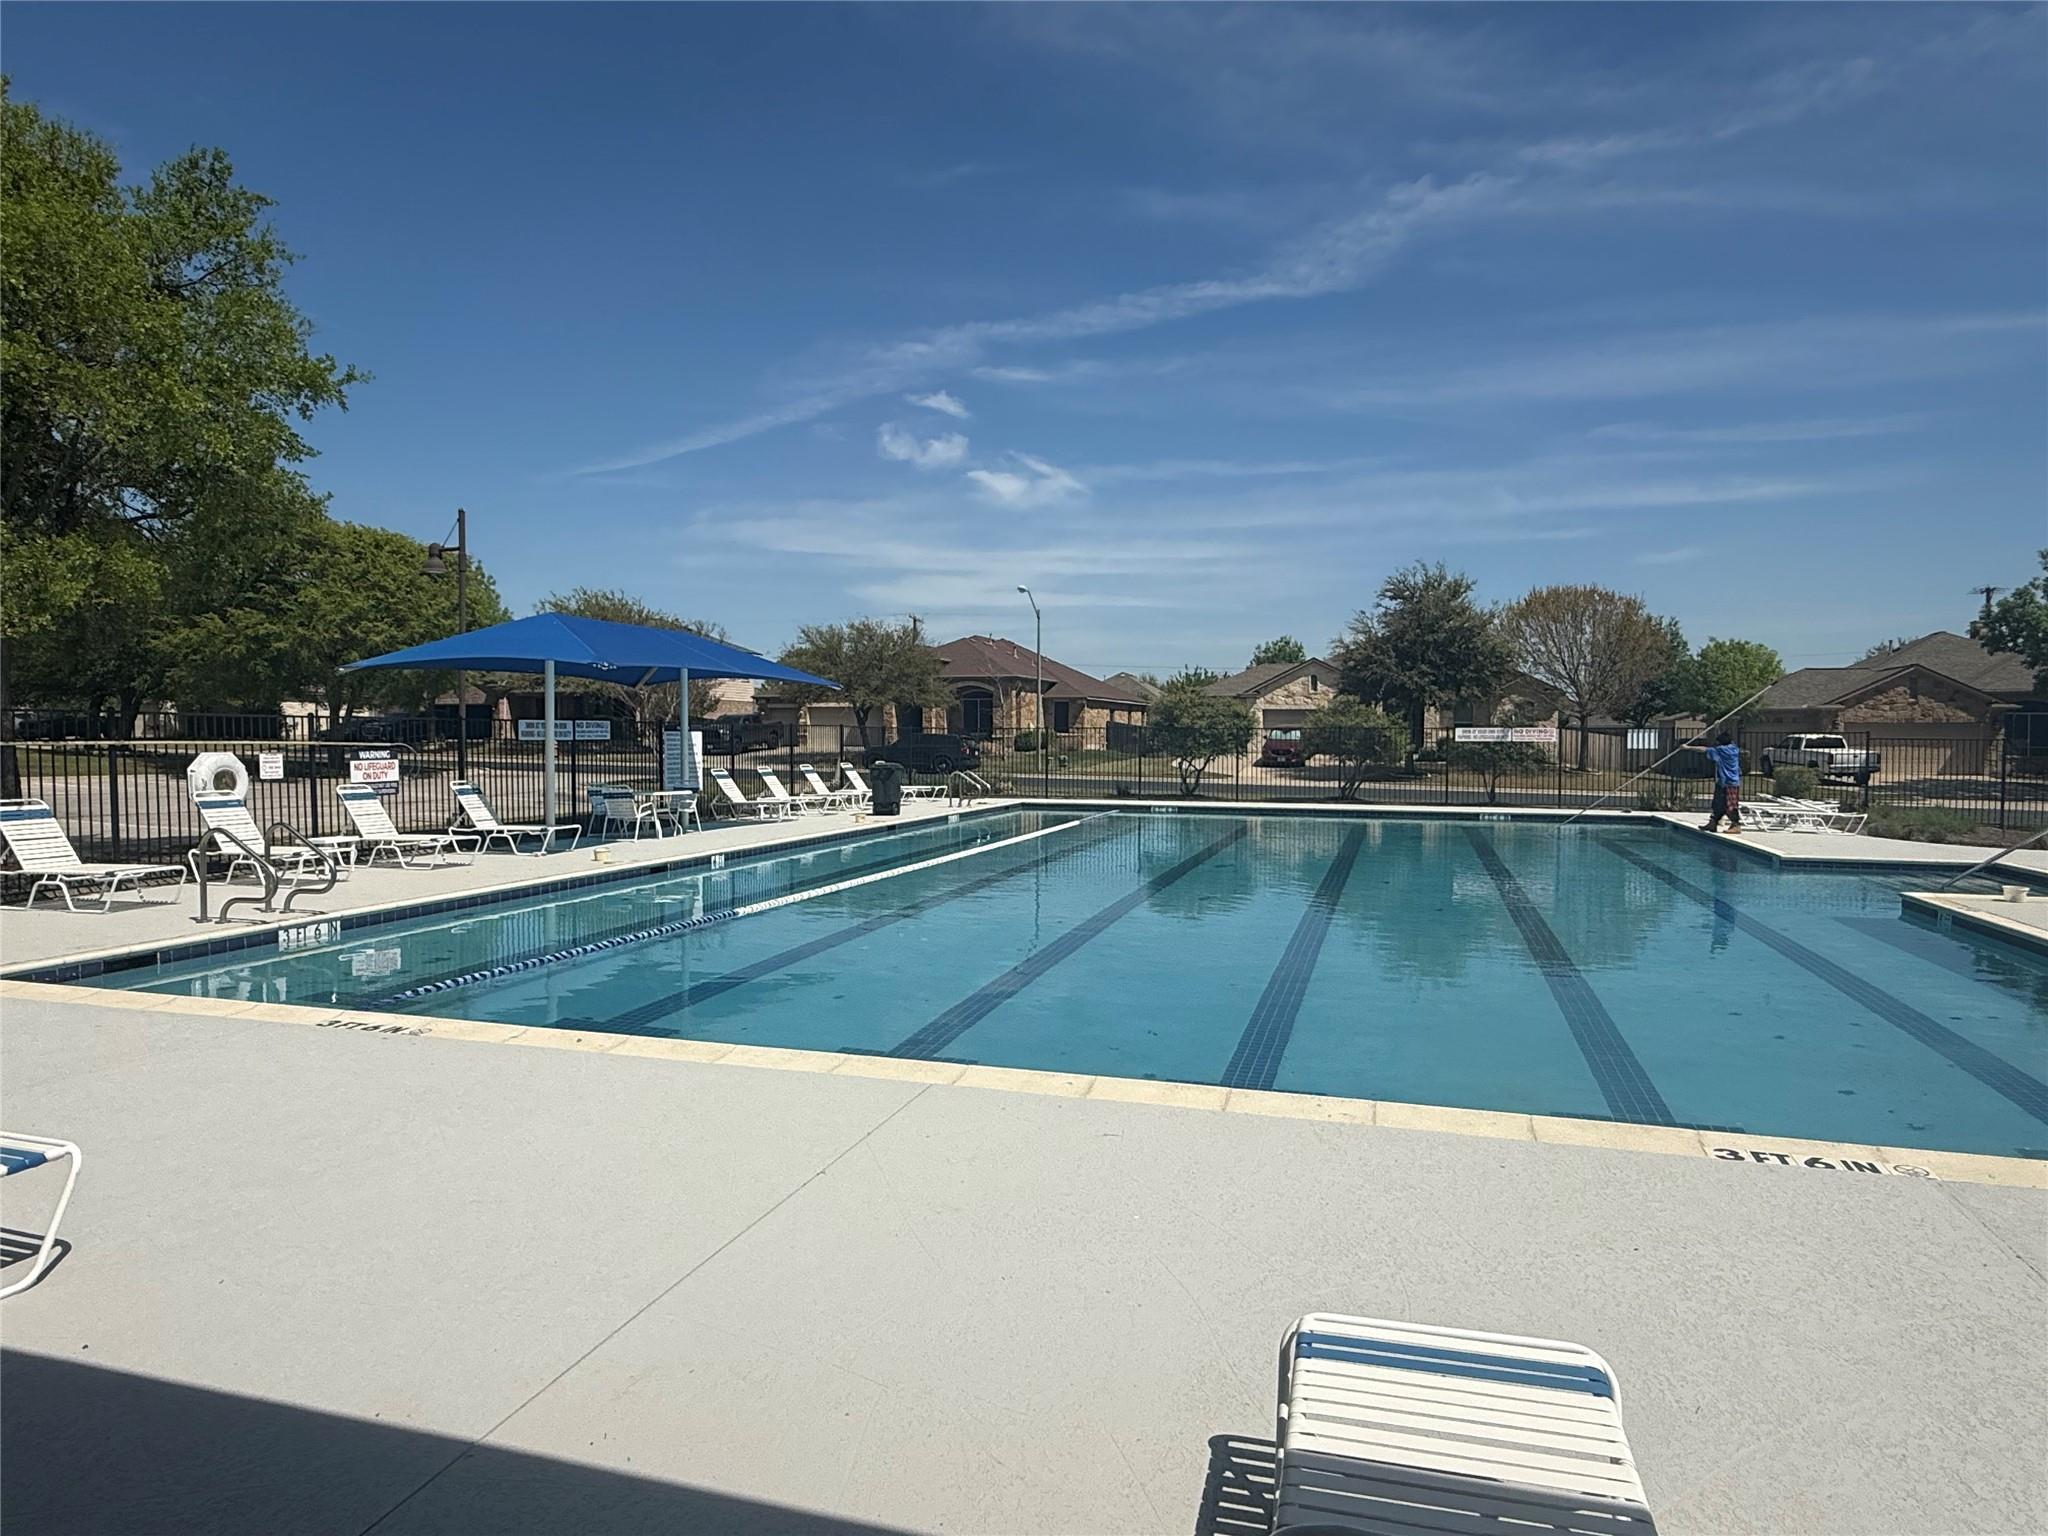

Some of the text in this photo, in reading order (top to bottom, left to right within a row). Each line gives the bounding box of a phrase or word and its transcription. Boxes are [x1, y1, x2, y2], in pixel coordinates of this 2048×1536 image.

[358, 750, 390, 759] WARNING
[364, 762, 395, 770] LIFEGUARD
[363, 771, 388, 780] ON DUTY
[314, 923, 322, 937] 6
[1713, 1148, 1882, 1174] 3 FT 6 IN
